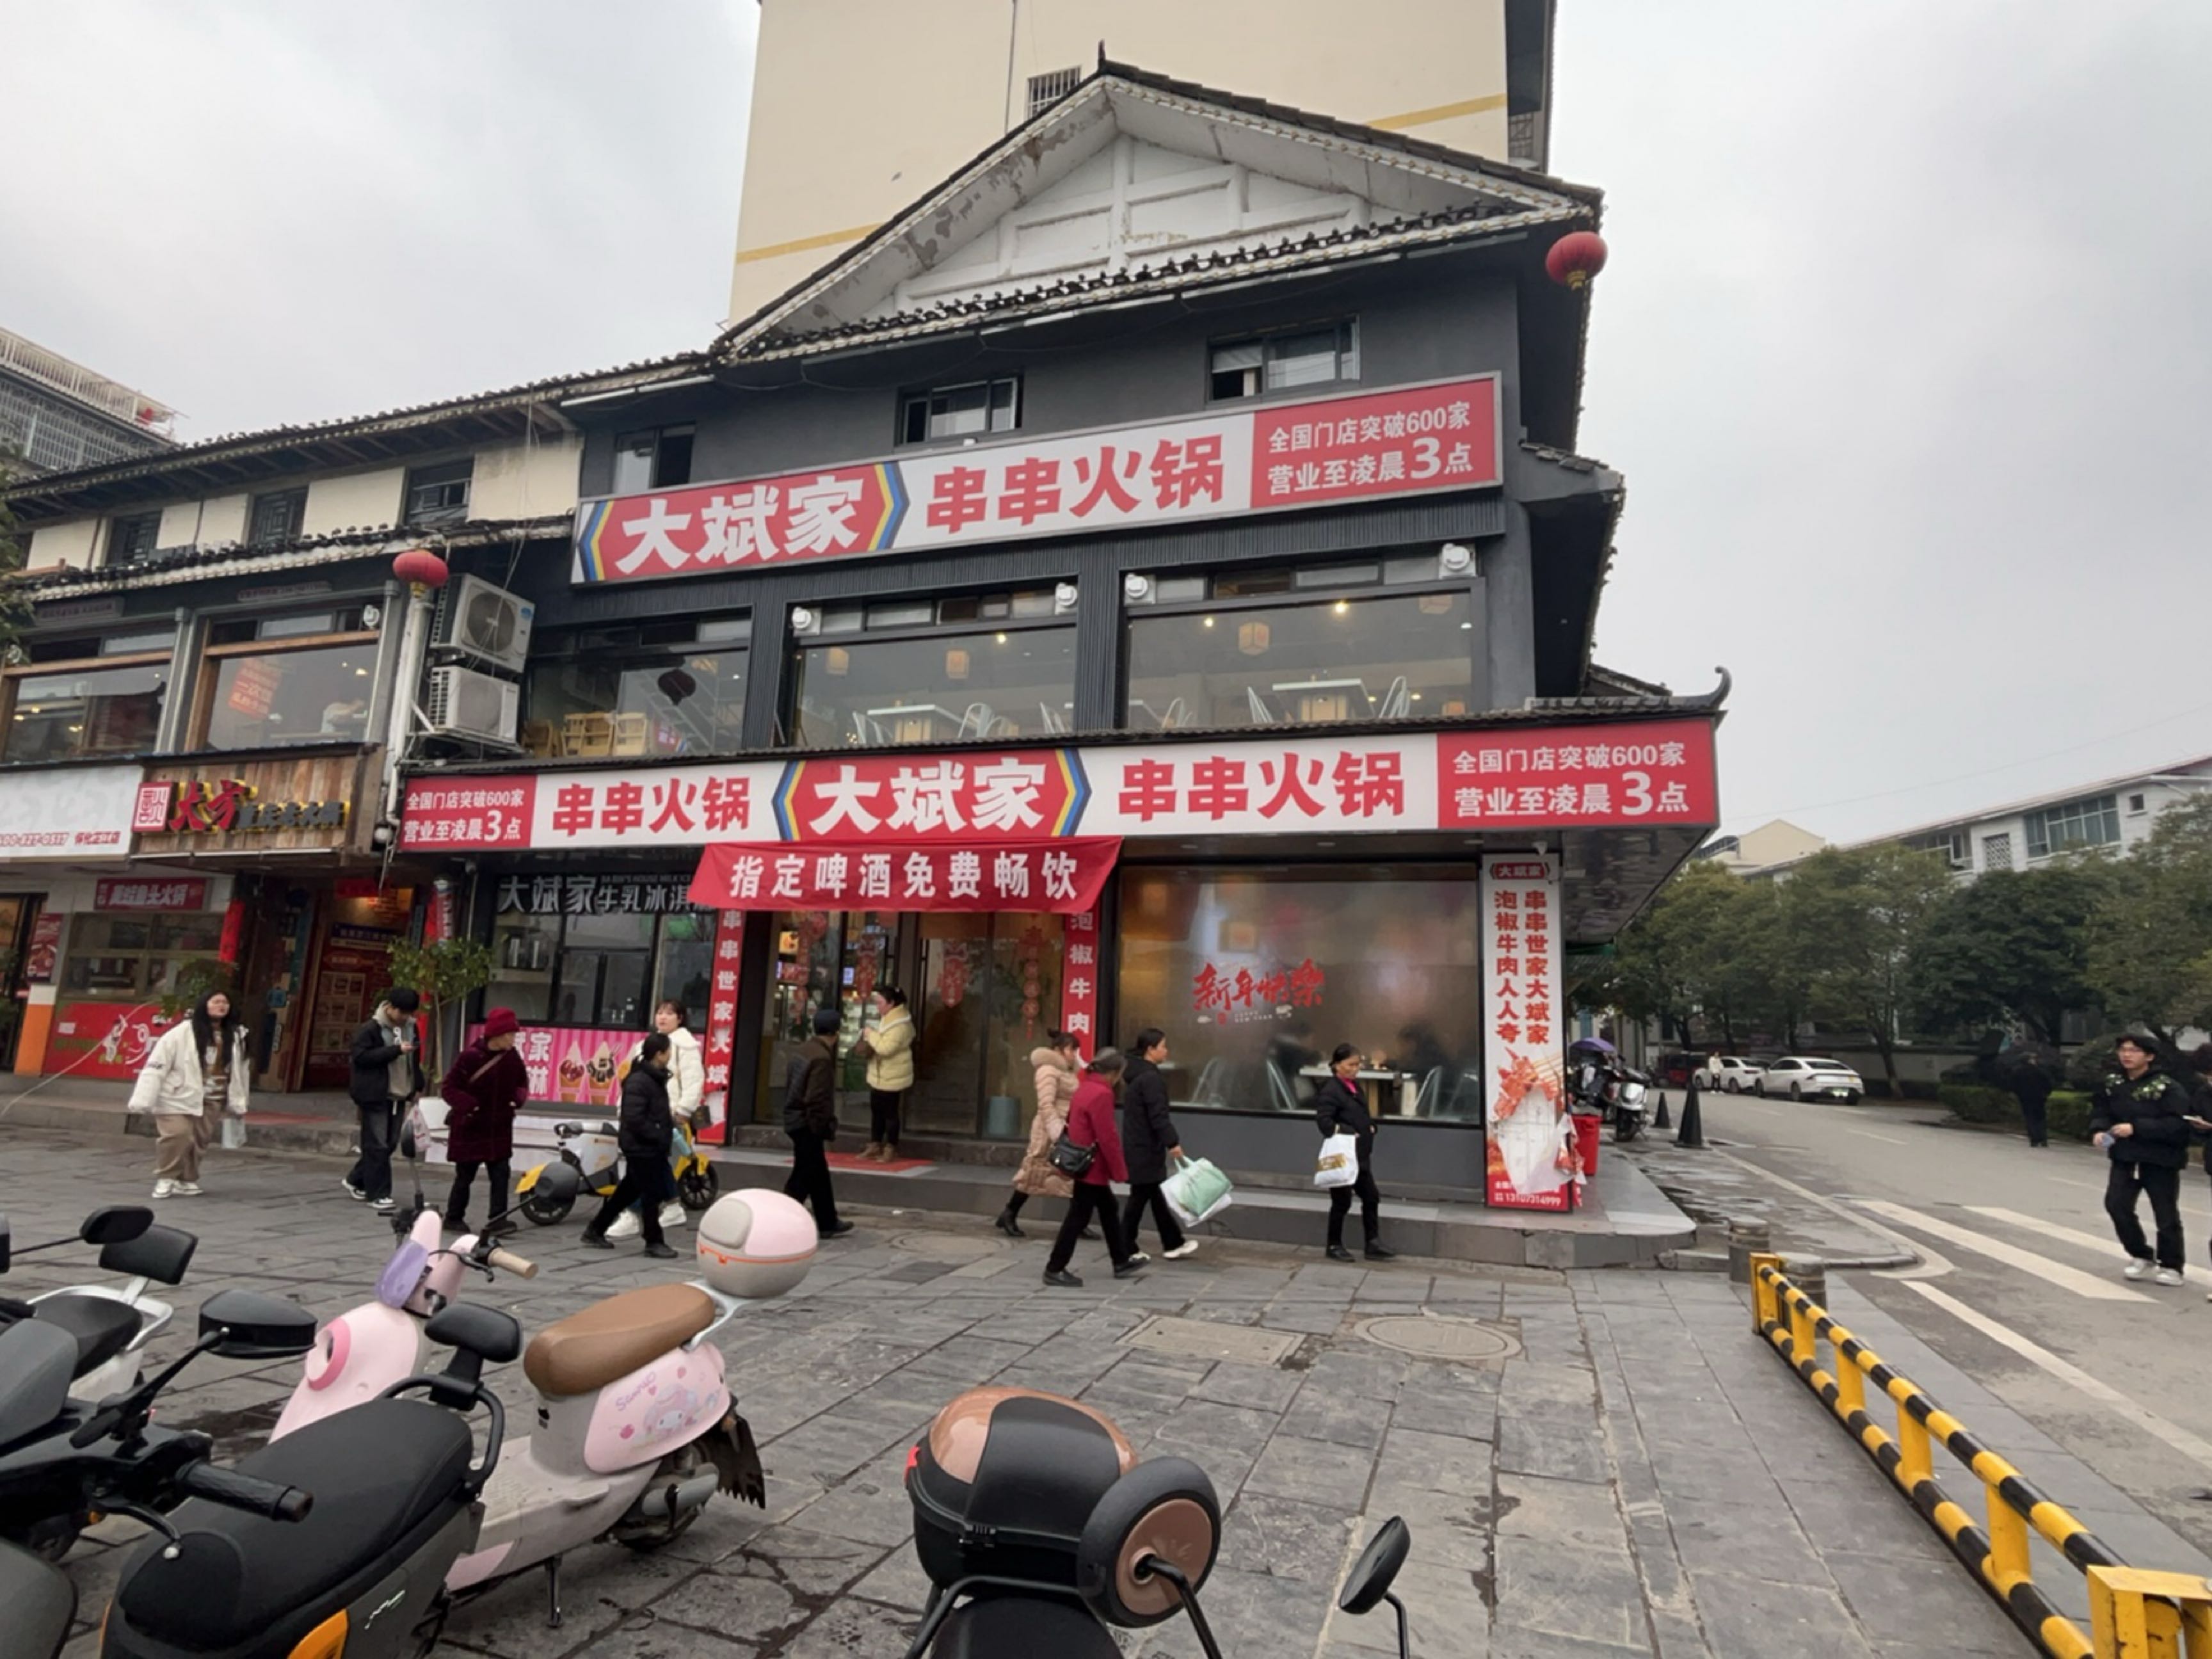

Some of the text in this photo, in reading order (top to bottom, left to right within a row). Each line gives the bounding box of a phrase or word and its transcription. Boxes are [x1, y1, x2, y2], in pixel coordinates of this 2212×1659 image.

[1267, 402, 1472, 456] 全国门店突破600家
[1267, 434, 1473, 499] 营业至凌晨3点
[616, 435, 1224, 574] 大斌家 串串火锅
[1454, 741, 1686, 774] 全国门店突破600家
[406, 790, 524, 810] 全国门店突破600家
[552, 751, 1405, 836] 串串火锅 大斌家 串串火锅
[1454, 772, 1689, 817] 营业至凌晨3点
[404, 810, 520, 842] 营业至凌晨3点
[497, 875, 597, 913] 大斌家
[730, 851, 1078, 900] 指定啤酒免费畅饮
[1494, 890, 1521, 1045] 泡椒牛肉人人夸
[1525, 890, 1550, 1046] 串串世家大斌家
